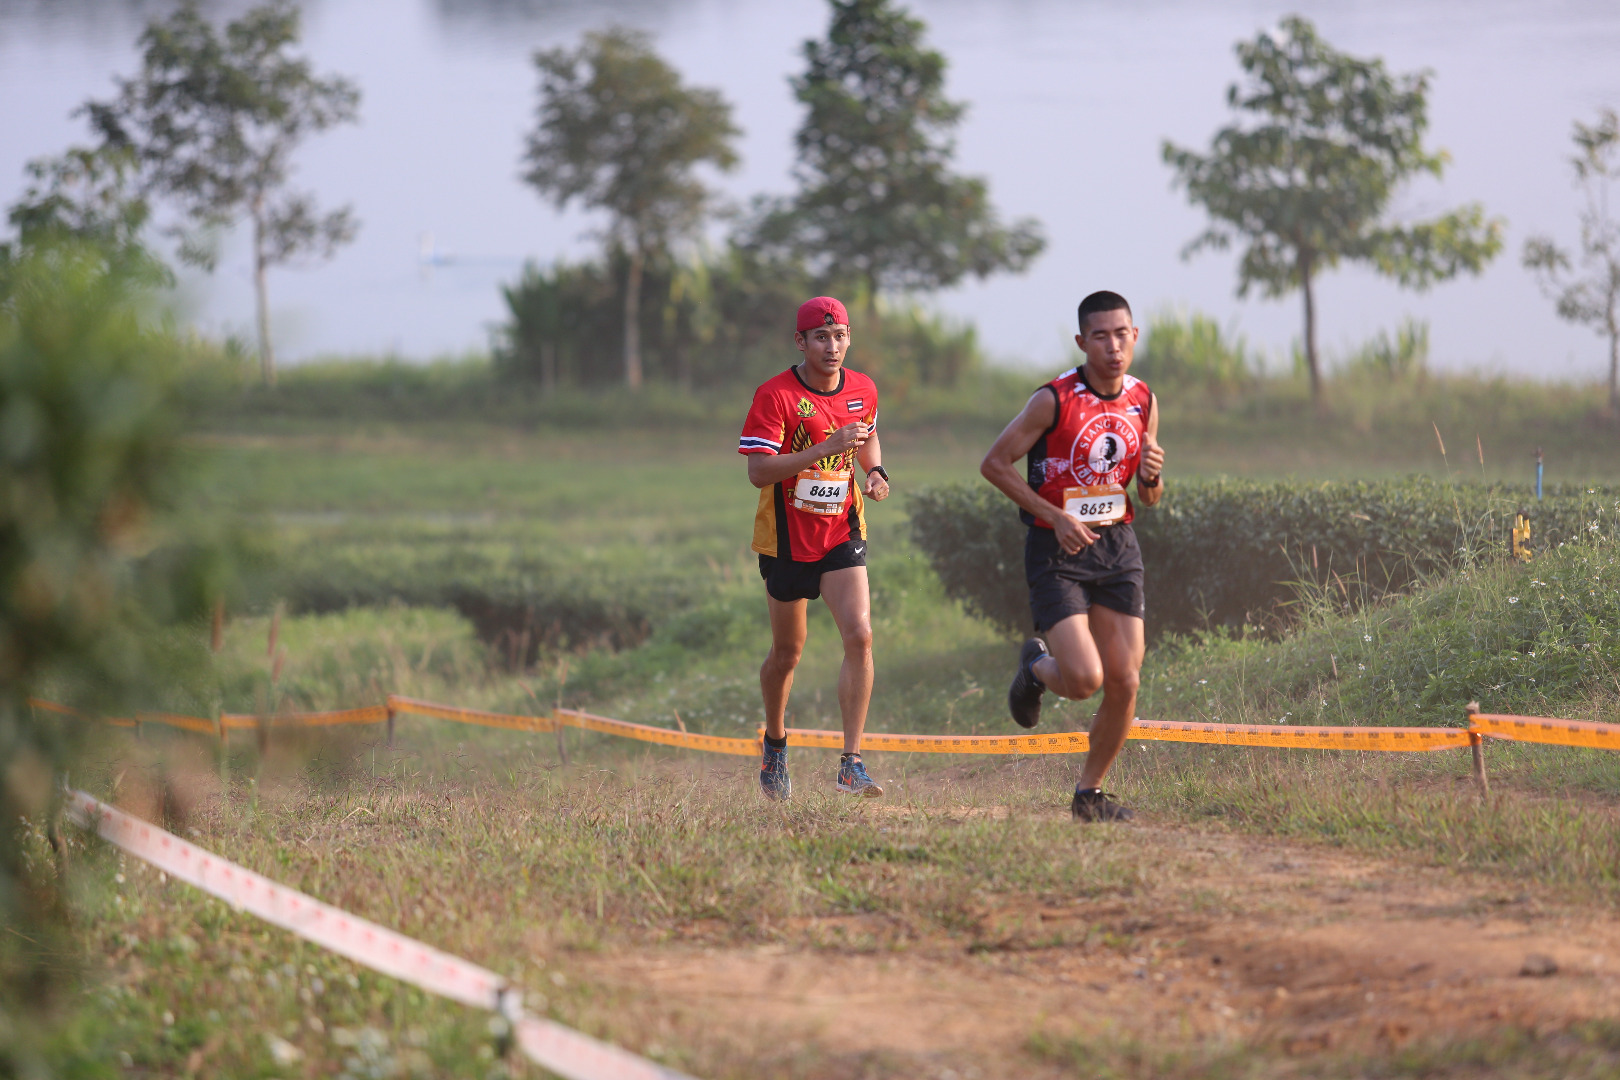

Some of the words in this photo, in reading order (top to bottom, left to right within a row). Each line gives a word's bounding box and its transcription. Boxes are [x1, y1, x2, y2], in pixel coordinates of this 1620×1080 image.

[1080, 418, 1111, 449] SIANG
[1115, 421, 1136, 448] PURE
[809, 485, 841, 498] 8634
[1080, 501, 1113, 515] 8623
